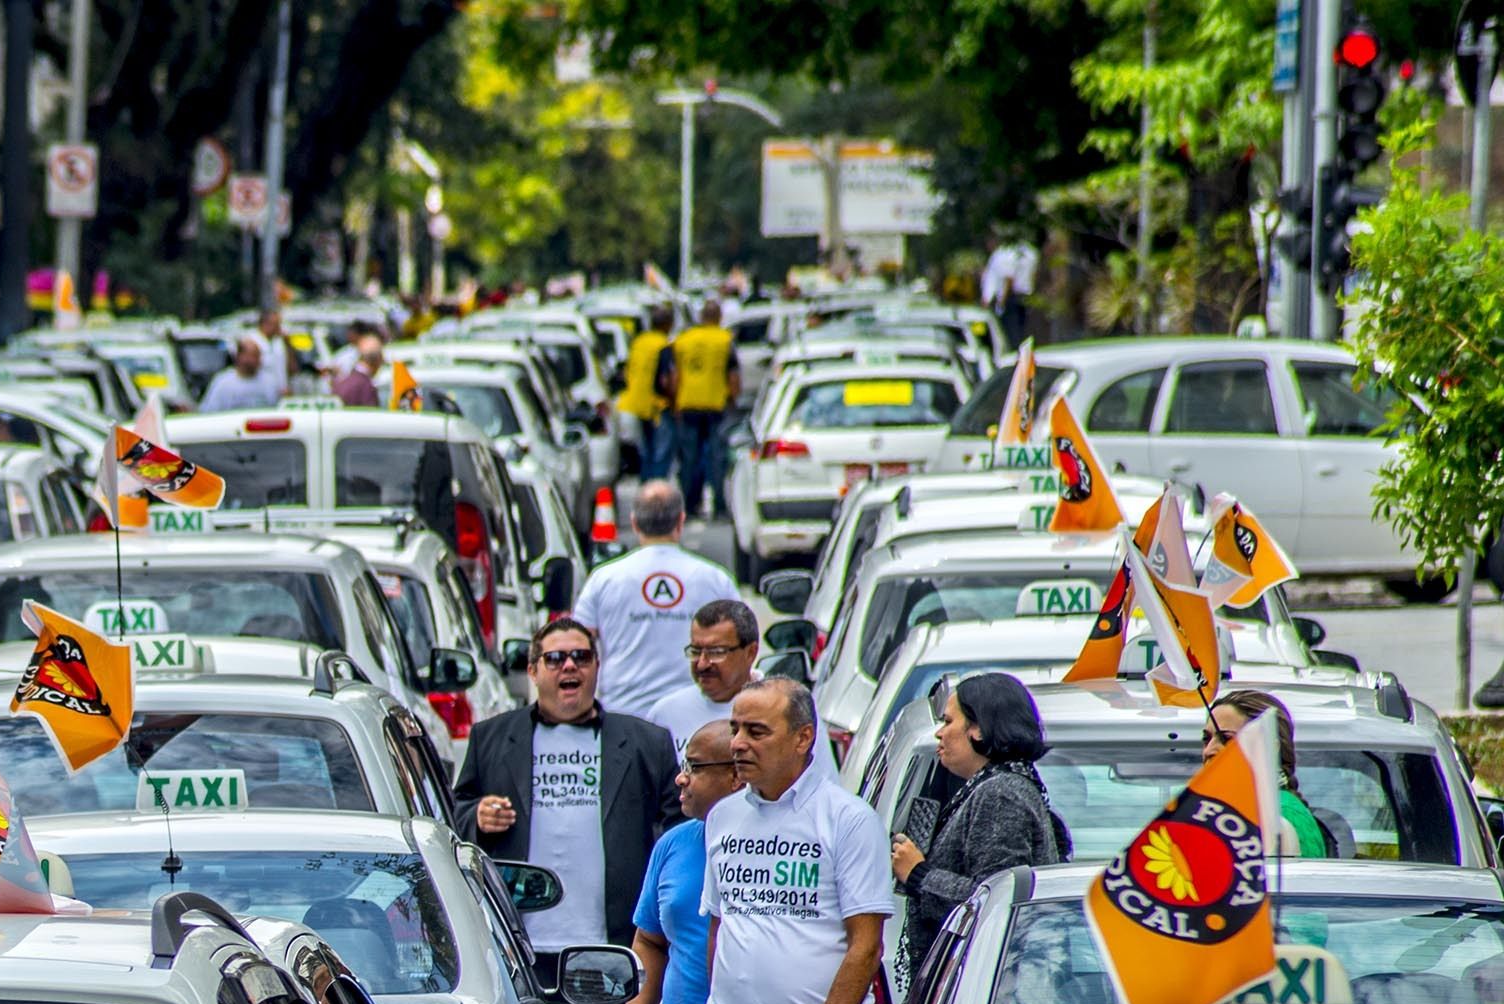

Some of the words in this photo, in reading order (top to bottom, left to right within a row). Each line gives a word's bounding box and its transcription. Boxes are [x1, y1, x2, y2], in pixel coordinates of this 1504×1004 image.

[1005, 447, 1051, 468] TAXI
[150, 511, 204, 532] TAXI
[1031, 587, 1093, 613] TAXI
[97, 607, 155, 632] TAXI
[135, 640, 185, 667] AXI
[147, 777, 238, 807] TAXI
[721, 833, 822, 859] Vereadores
[718, 862, 771, 884] Votem
[774, 860, 820, 889] SIM
[790, 906, 821, 920] ilegais
